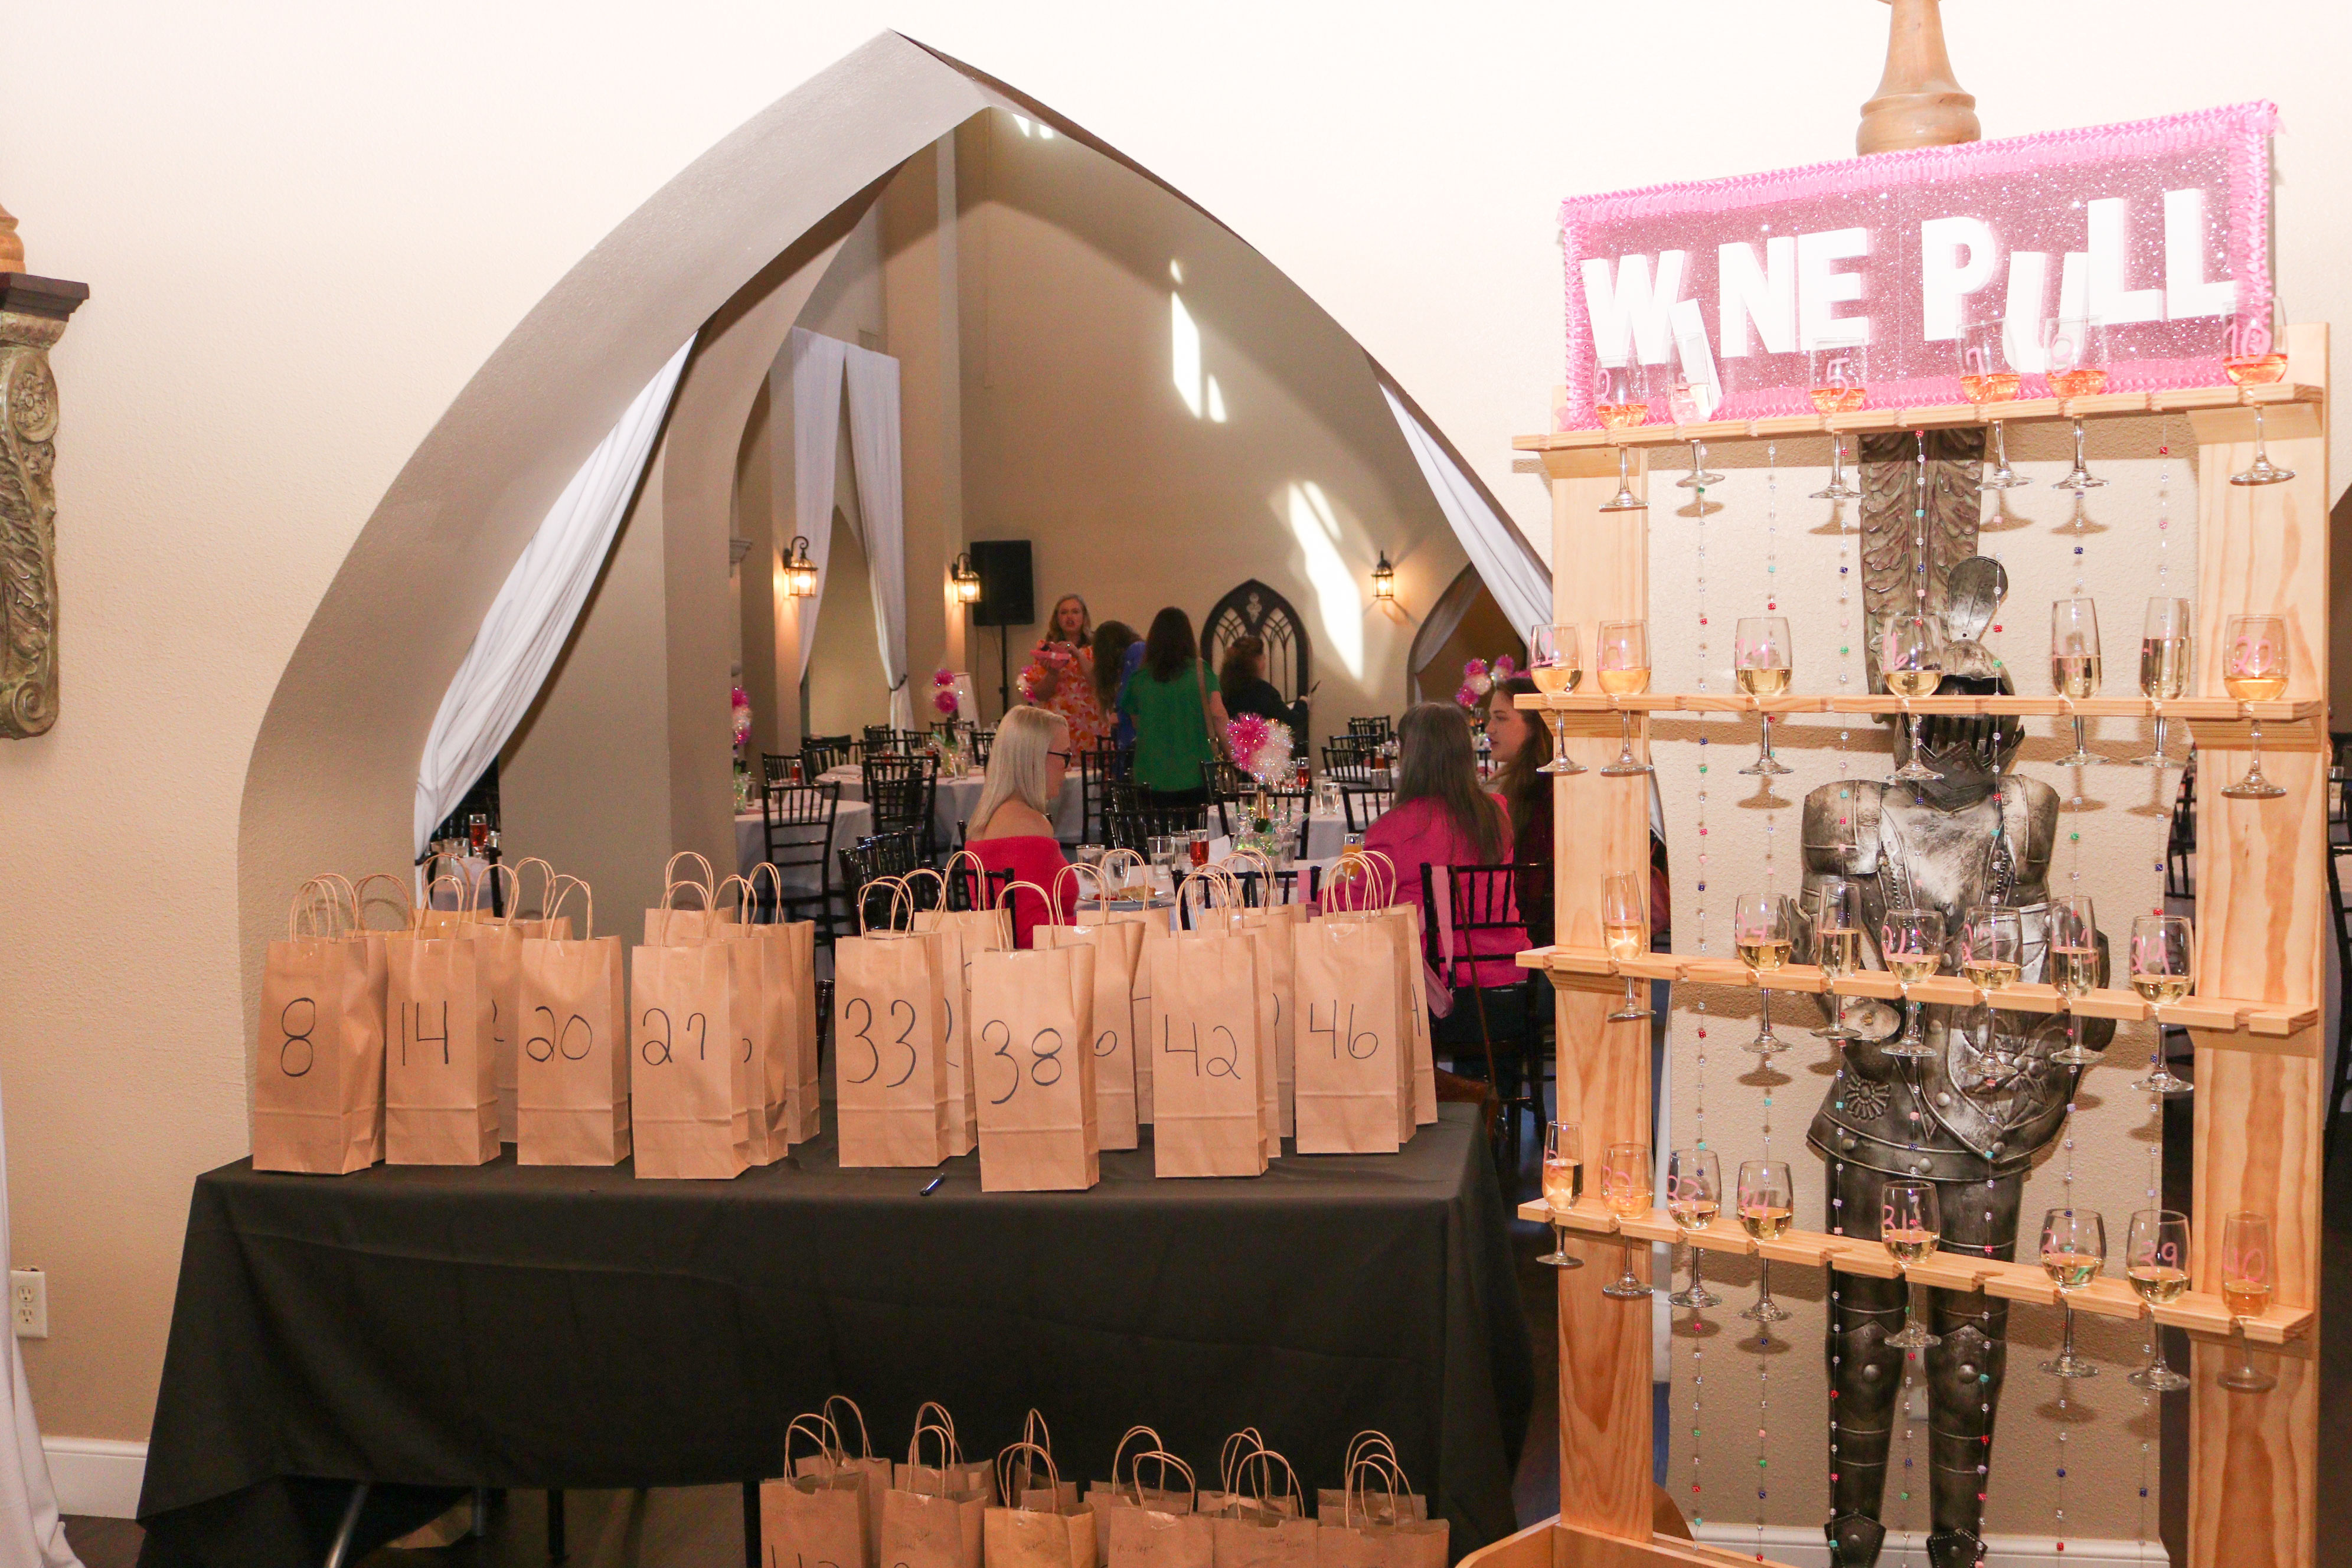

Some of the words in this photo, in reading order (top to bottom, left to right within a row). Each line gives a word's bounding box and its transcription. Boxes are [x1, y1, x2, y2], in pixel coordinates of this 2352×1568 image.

[1580, 228, 1870, 411] WINE
[1921, 188, 2237, 373] PULL
[2222, 323, 2273, 365] 10
[1826, 357, 1850, 400] 5
[1736, 638, 1769, 668] 14
[2232, 635, 2273, 677] 20
[2130, 936, 2171, 978] 29
[280, 997, 315, 1077] 8
[402, 1001, 449, 1066] 14
[526, 1006, 592, 1062] 20
[642, 1008, 707, 1065] 27
[845, 998, 917, 1087] 33
[1165, 1014, 1241, 1079] 42
[1309, 999, 1378, 1059] 46
[982, 1020, 1062, 1104] 38
[1738, 1187, 1770, 1223] 34
[2135, 1242, 2178, 1279] 39
